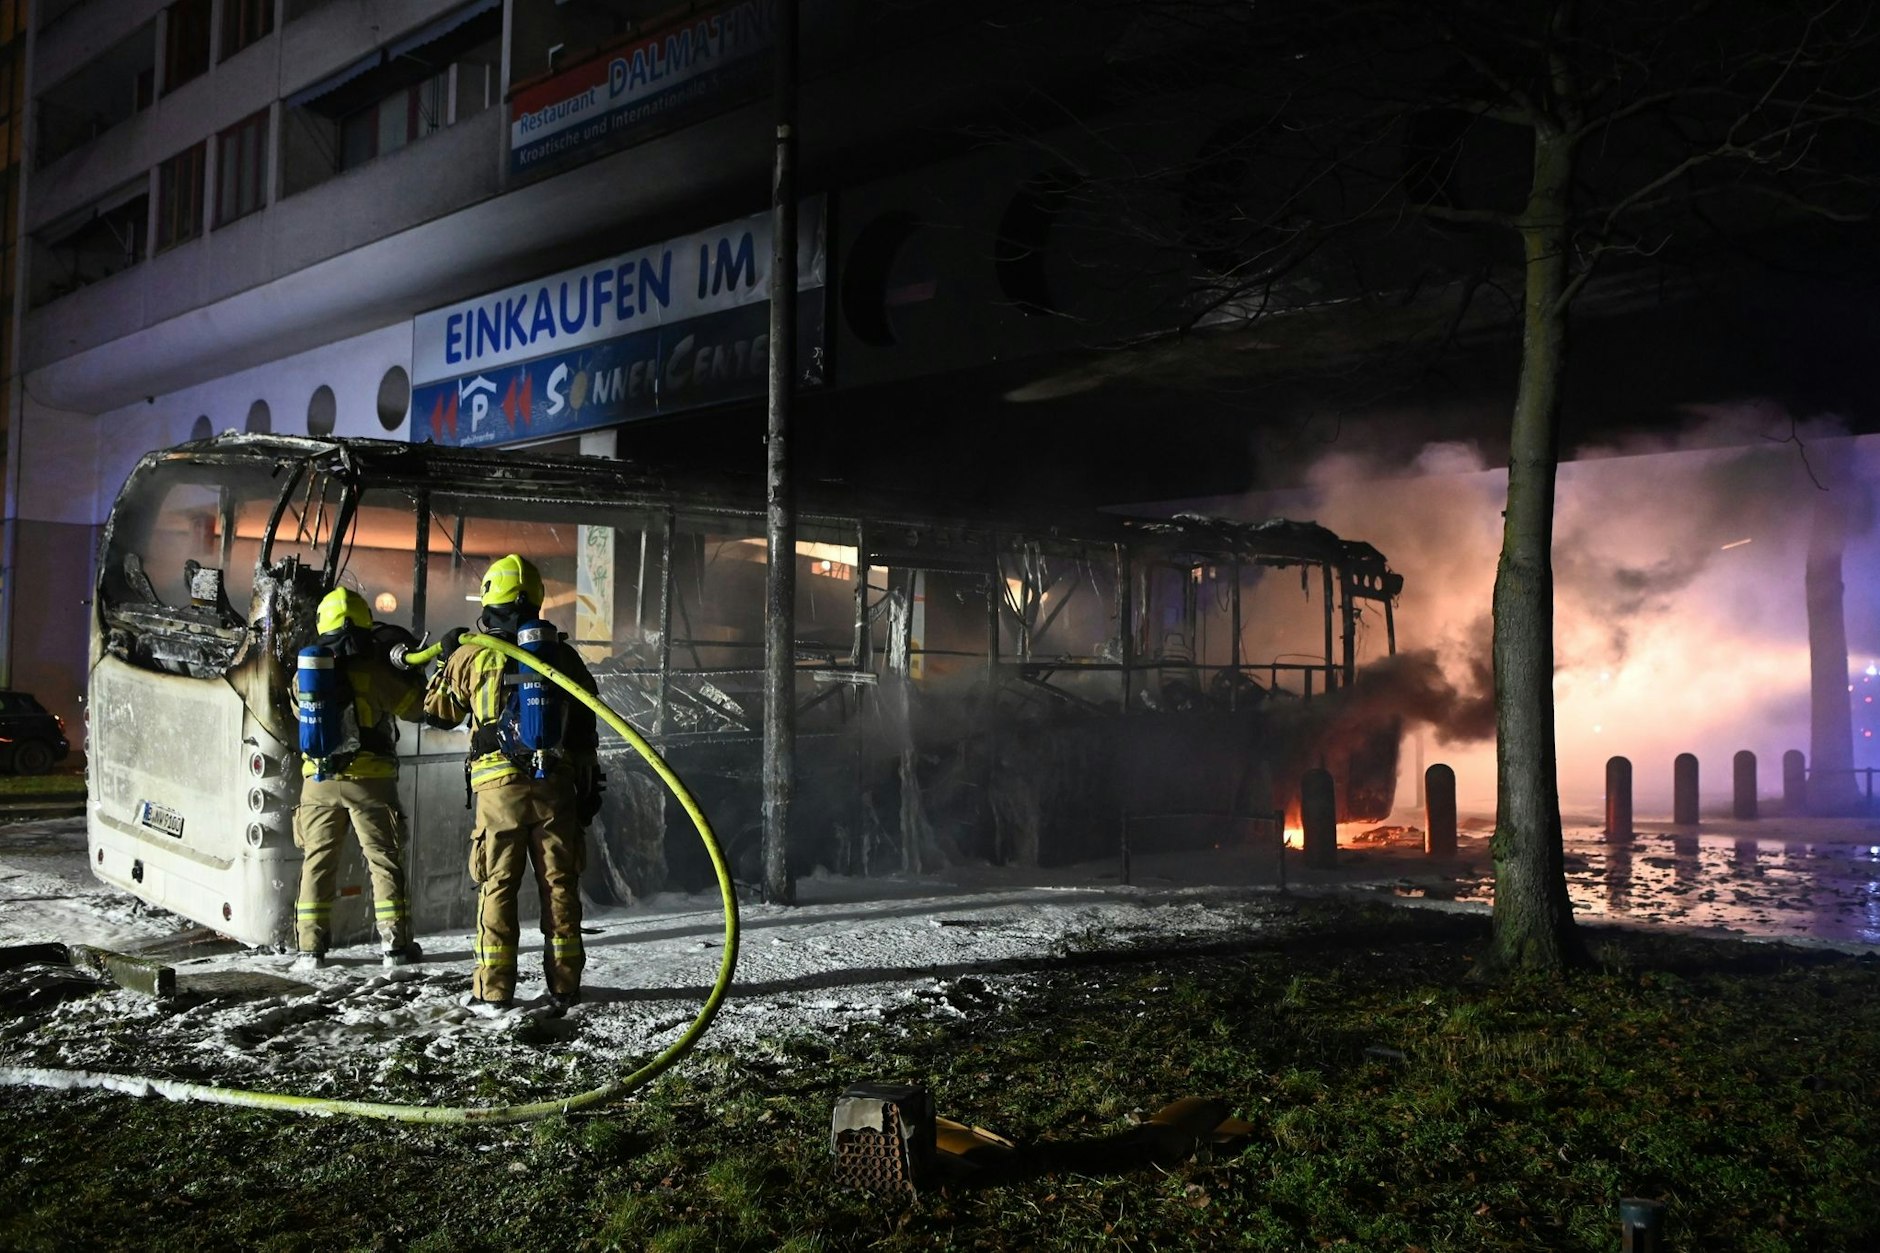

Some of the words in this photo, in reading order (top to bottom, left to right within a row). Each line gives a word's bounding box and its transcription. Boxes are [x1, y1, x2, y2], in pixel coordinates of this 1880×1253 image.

[519, 131, 579, 166] Kroatische
[583, 113, 608, 139] und
[610, 81, 706, 130] Internationale
[520, 86, 595, 135] Restaurant
[446, 250, 672, 364] EINKAUFEN
[698, 232, 755, 299] IM
[470, 394, 488, 433] P
[526, 697, 540, 706] 300
